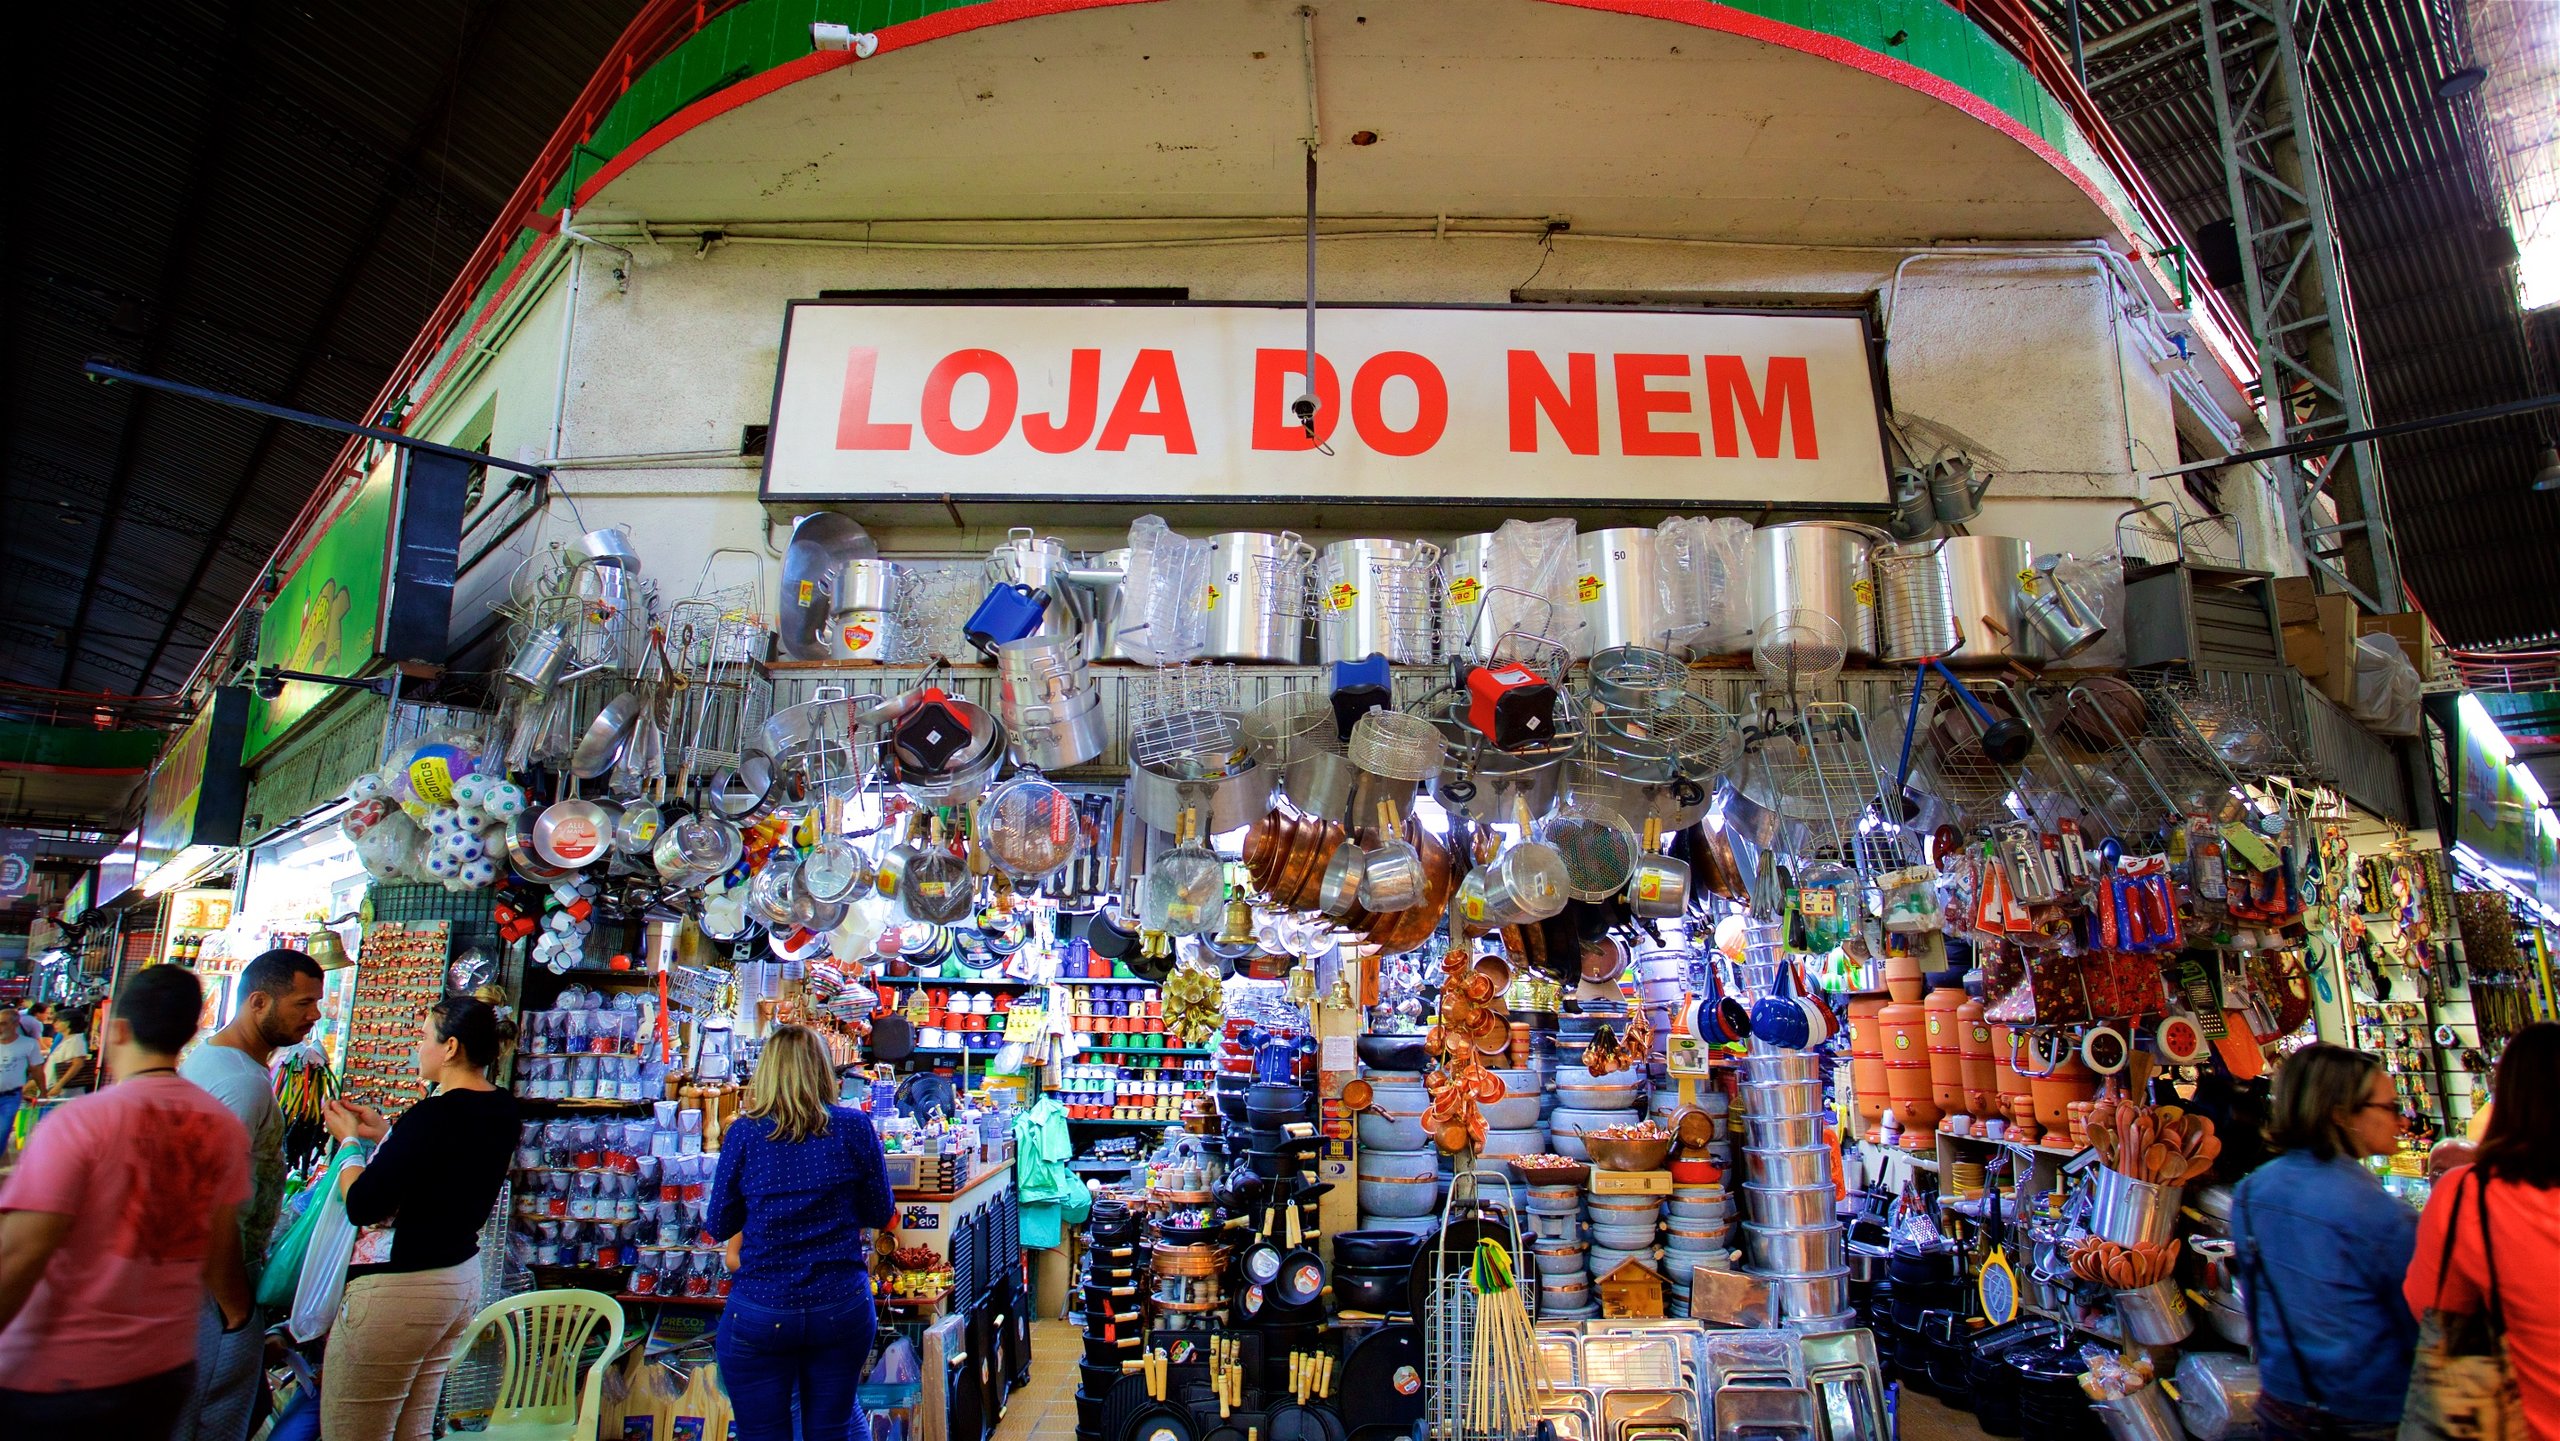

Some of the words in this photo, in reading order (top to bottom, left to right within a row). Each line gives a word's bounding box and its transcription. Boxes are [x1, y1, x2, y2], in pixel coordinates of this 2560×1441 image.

[836, 347, 1198, 456] LOJA
[1252, 348, 1449, 457] DO
[1507, 349, 1820, 461] NEM
[1613, 550, 1626, 560] 50
[1227, 573, 1239, 583] 45
[421, 762, 446, 803] PROMOS
[906, 1205, 928, 1215] use
[918, 1216, 937, 1227] elo
